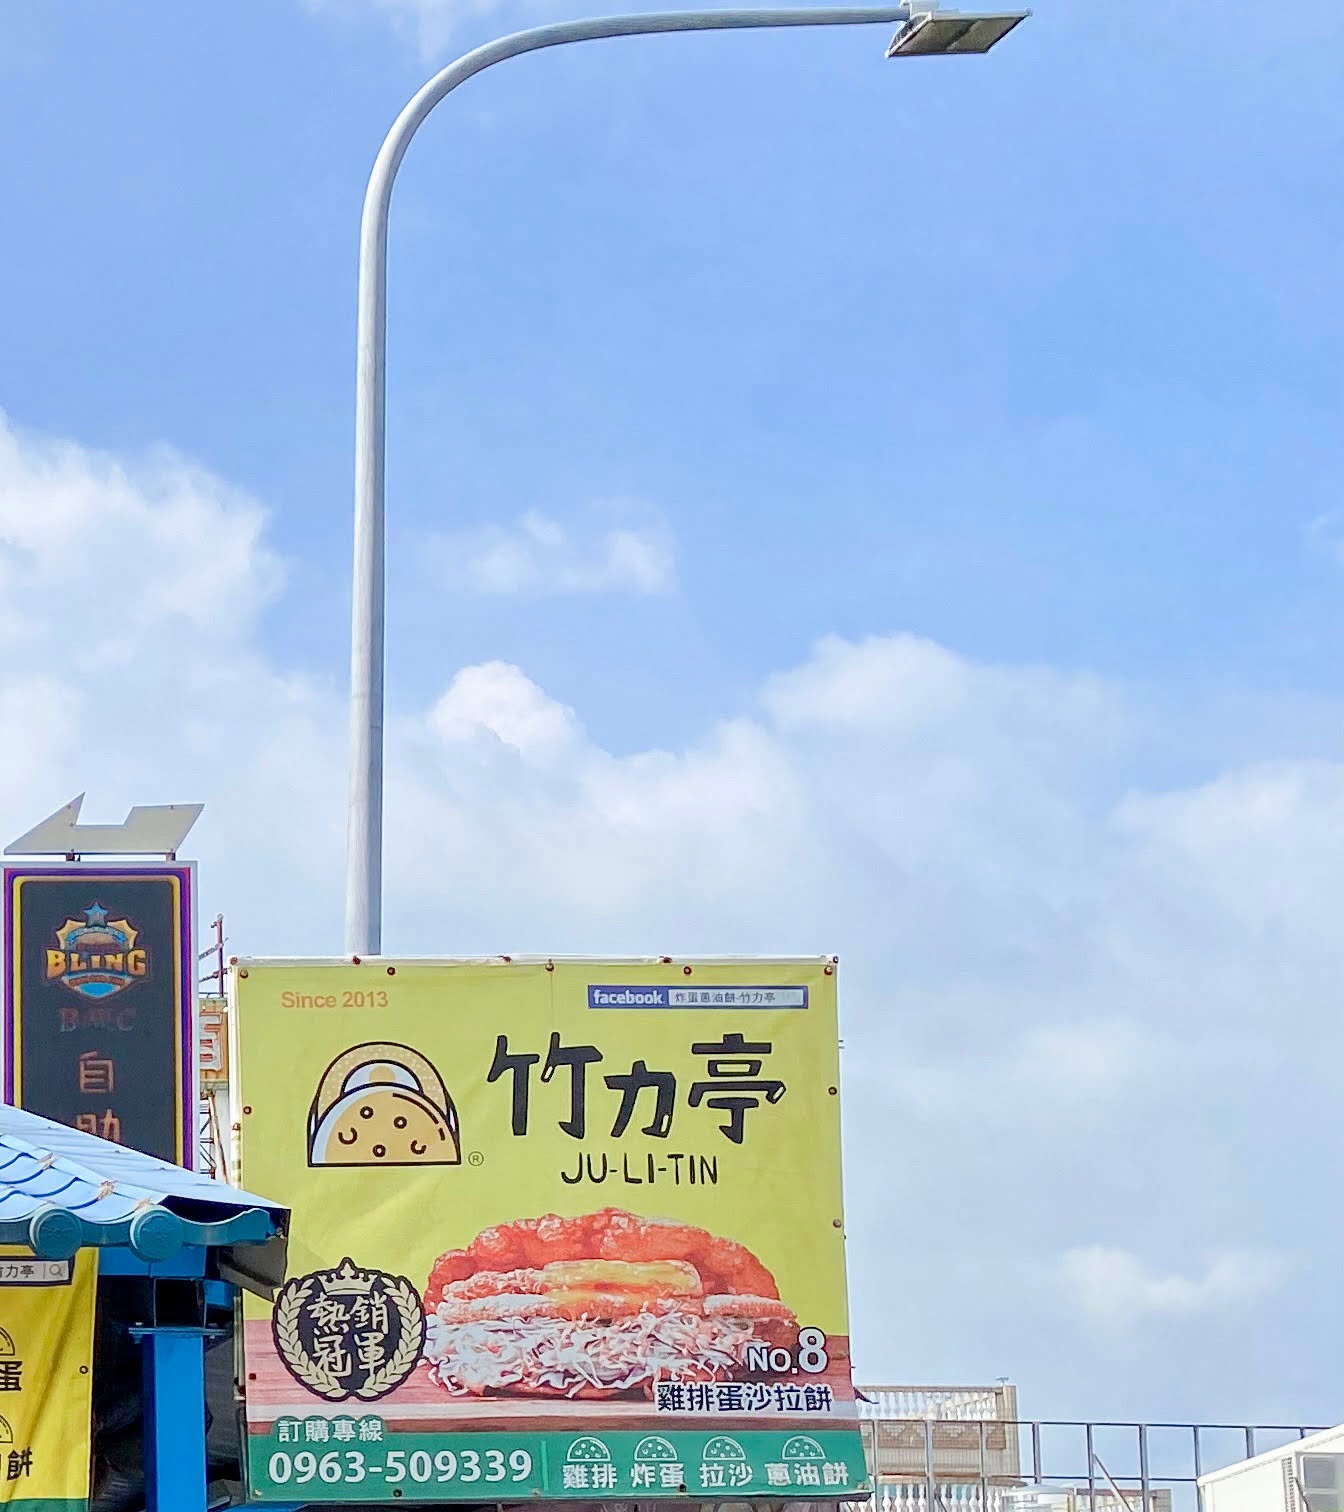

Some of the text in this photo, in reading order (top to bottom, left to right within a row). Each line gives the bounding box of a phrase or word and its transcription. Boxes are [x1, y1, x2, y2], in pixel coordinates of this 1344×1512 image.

[45, 948, 147, 979] BLING
[281, 990, 389, 1009] Since 2013
[593, 989, 663, 1005] facebook
[487, 1032, 786, 1145] 竹力亭
[561, 1153, 719, 1186] JU-LI-TIN
[656, 1382, 833, 1413] 雞排蛋沙拉餅
[277, 1419, 384, 1444] 訂購專線
[267, 1448, 534, 1485] 0963-509339
[562, 1463, 617, 1490] 雞排
[630, 1462, 685, 1489] 炸蛋
[700, 1462, 754, 1489] 拉沙
